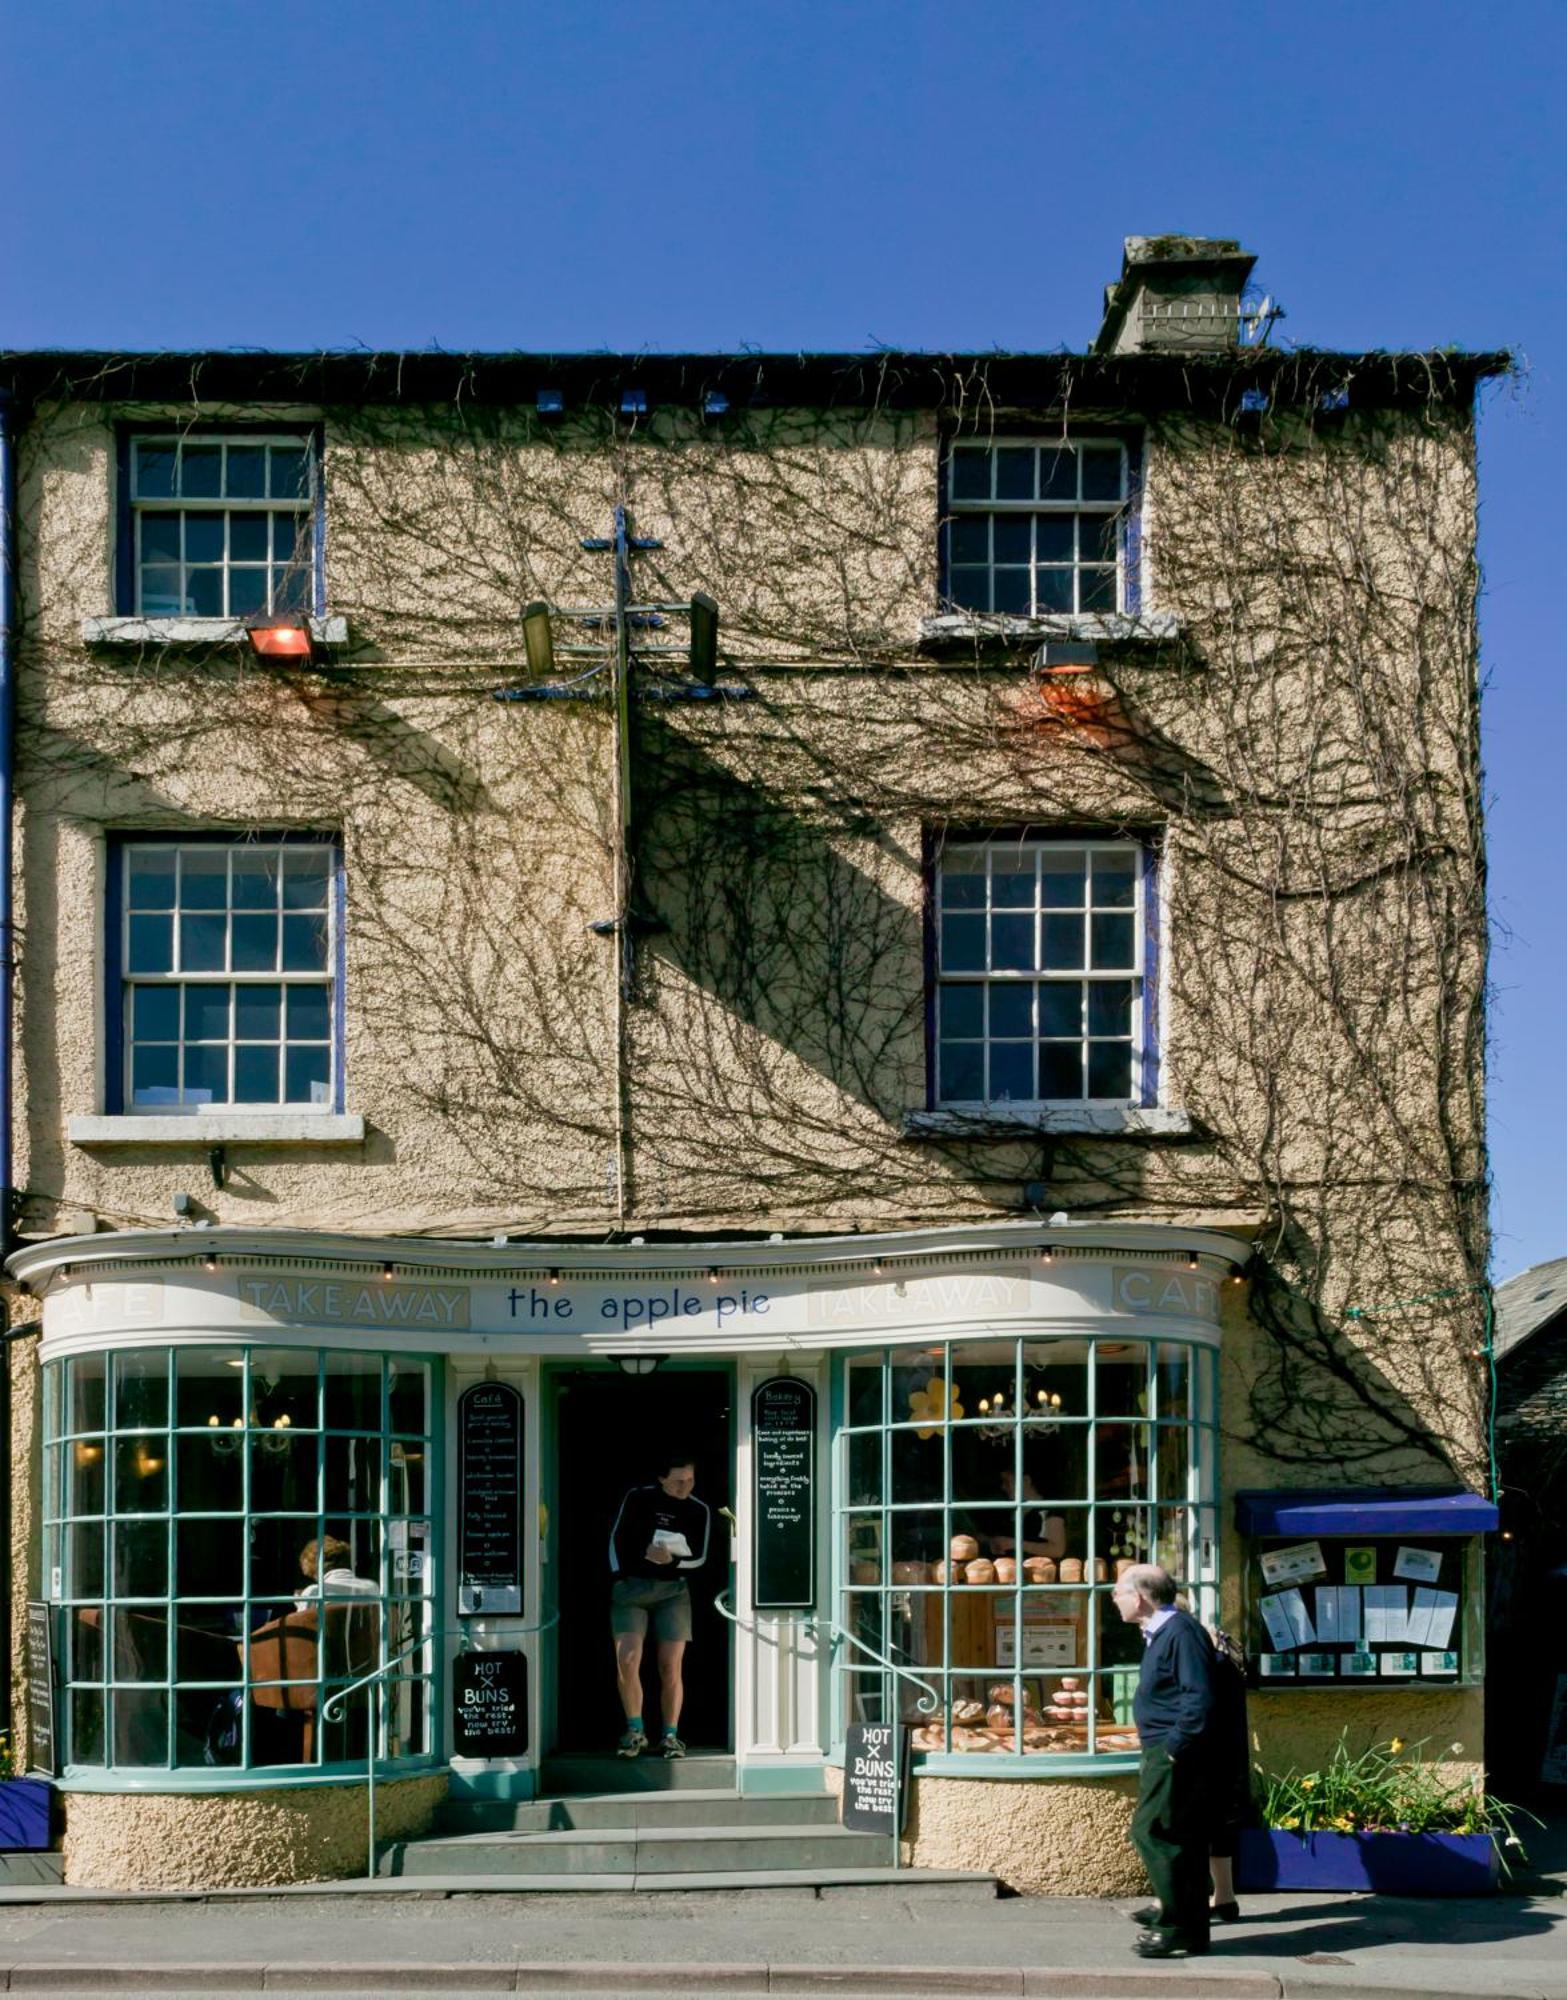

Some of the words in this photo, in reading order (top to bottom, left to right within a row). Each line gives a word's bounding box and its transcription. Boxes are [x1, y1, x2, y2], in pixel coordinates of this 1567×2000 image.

[508, 1288, 573, 1318] the
[600, 1288, 702, 1330] apple
[715, 1290, 771, 1328] pie
[474, 1662, 502, 1675] HOT
[464, 1688, 510, 1704] BUNS
[492, 1703, 515, 1712] tried
[463, 1712, 480, 1720] the
[467, 1721, 488, 1729] now
[862, 1728, 891, 1745] HOT
[854, 1757, 895, 1778] BUNS
[857, 1785, 872, 1795] the
[858, 1796, 877, 1804] now
[854, 1802, 869, 1811] the
